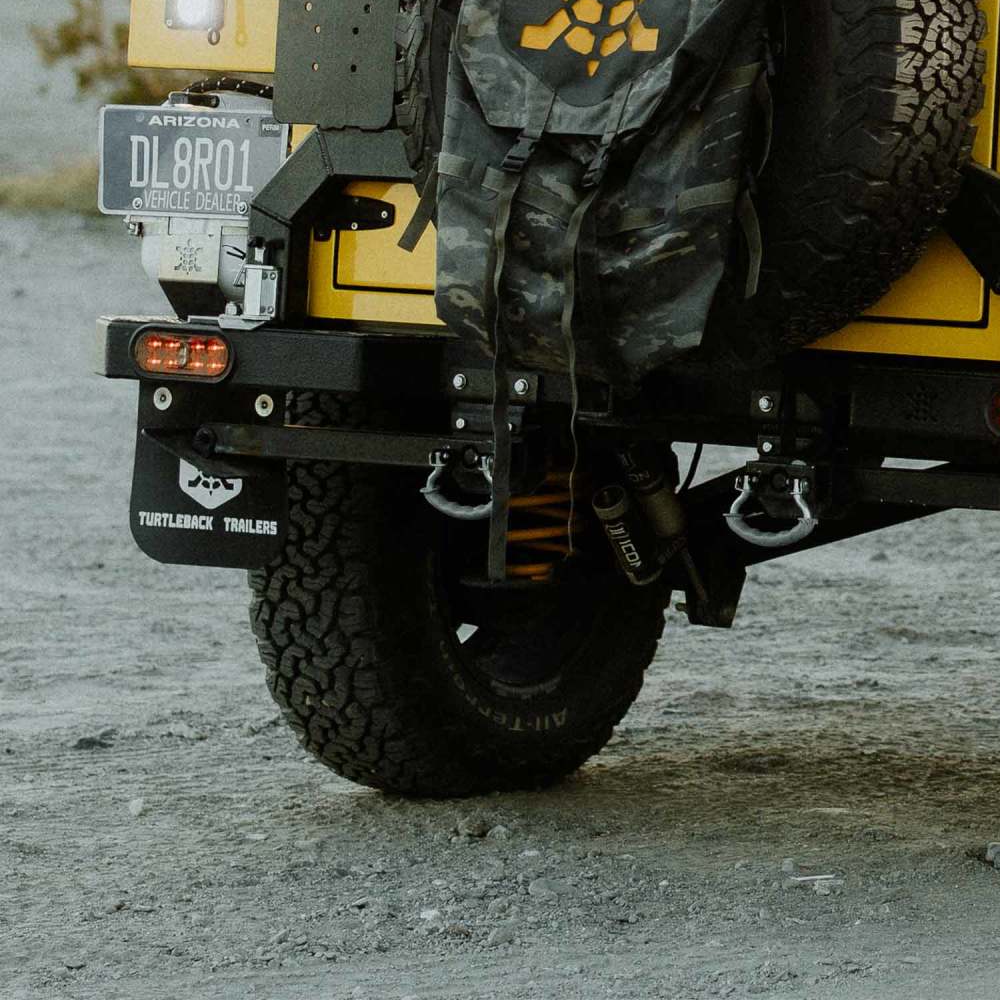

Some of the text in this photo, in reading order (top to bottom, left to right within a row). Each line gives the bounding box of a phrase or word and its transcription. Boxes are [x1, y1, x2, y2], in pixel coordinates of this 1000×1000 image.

[148, 115, 240, 128] ARIZONA
[143, 189, 241, 212] VEHICLE DEALER
[138, 511, 277, 535] TURTLEBACK TRAILERS
